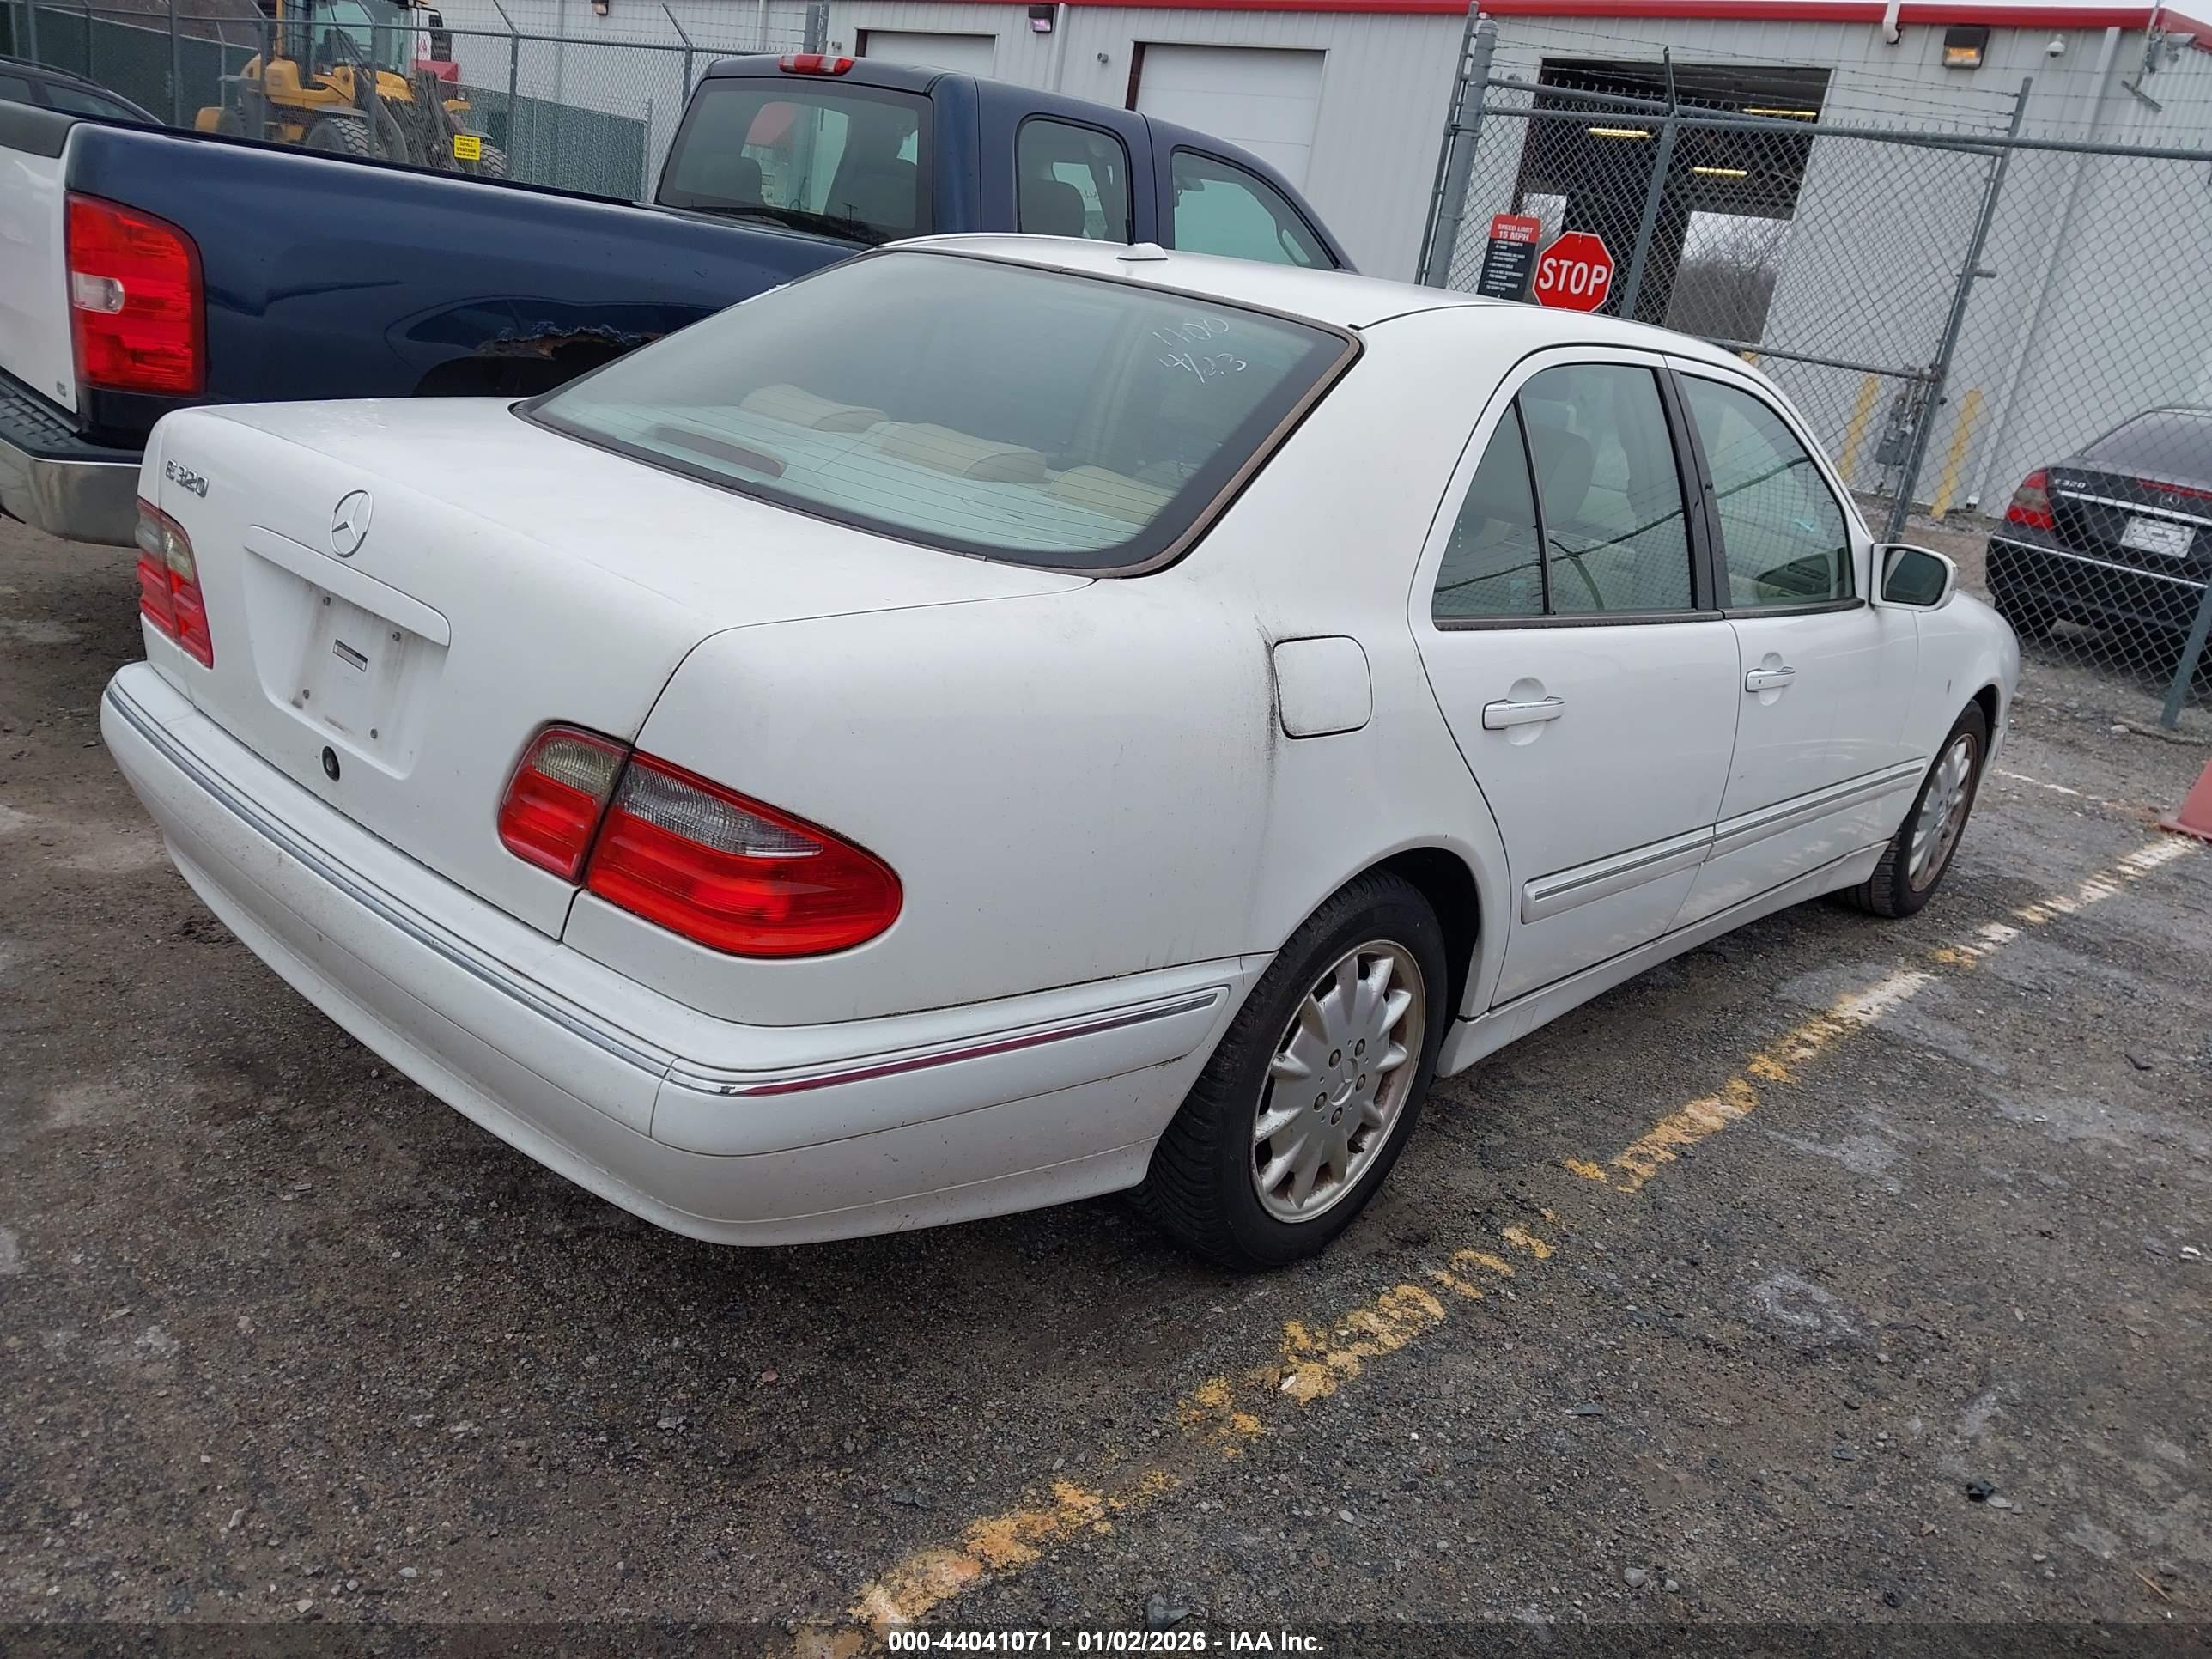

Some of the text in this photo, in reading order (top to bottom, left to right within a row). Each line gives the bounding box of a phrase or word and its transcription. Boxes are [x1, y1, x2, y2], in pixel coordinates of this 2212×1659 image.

[1498, 230, 1529, 241] 15 MPH
[1539, 257, 1607, 296] STOP
[176, 465, 210, 498] 320
